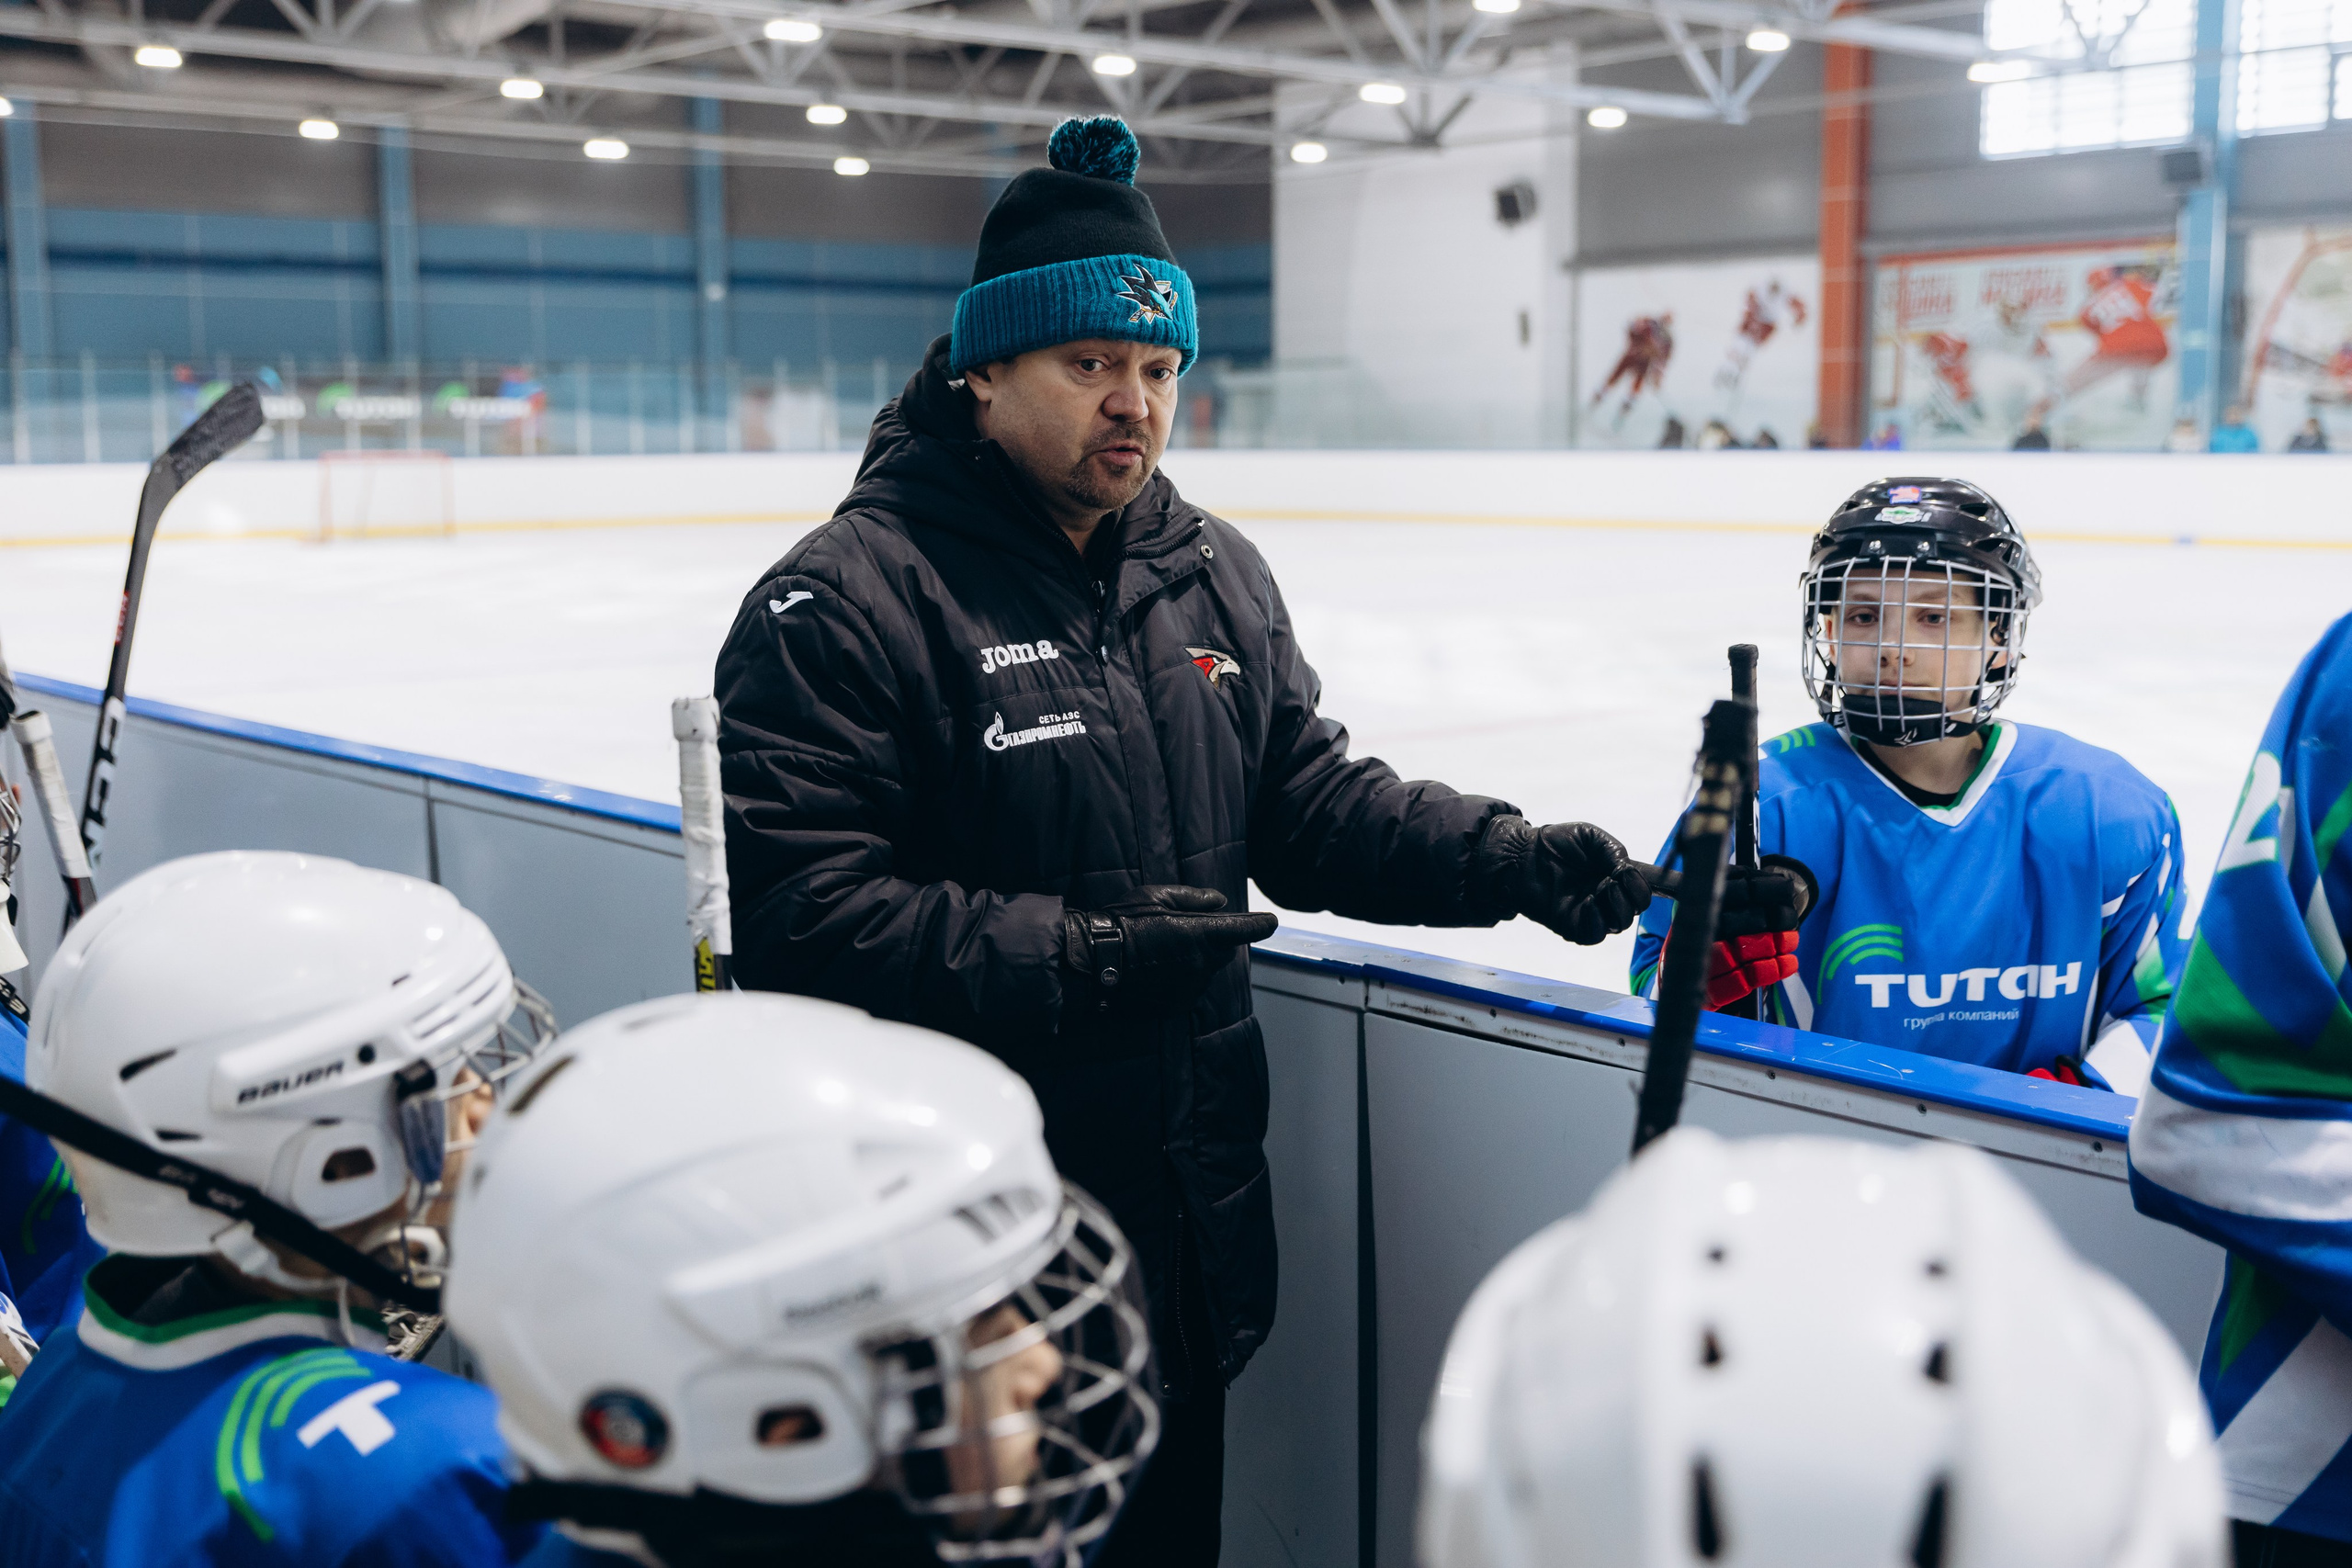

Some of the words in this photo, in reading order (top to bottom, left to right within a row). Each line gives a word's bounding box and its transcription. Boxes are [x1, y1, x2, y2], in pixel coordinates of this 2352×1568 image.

[980, 639, 1059, 674] Joma
[1038, 714, 1061, 725] СЕТЬ
[1062, 710, 1080, 722] АЗС
[1948, 1008, 2020, 1021] компаний
